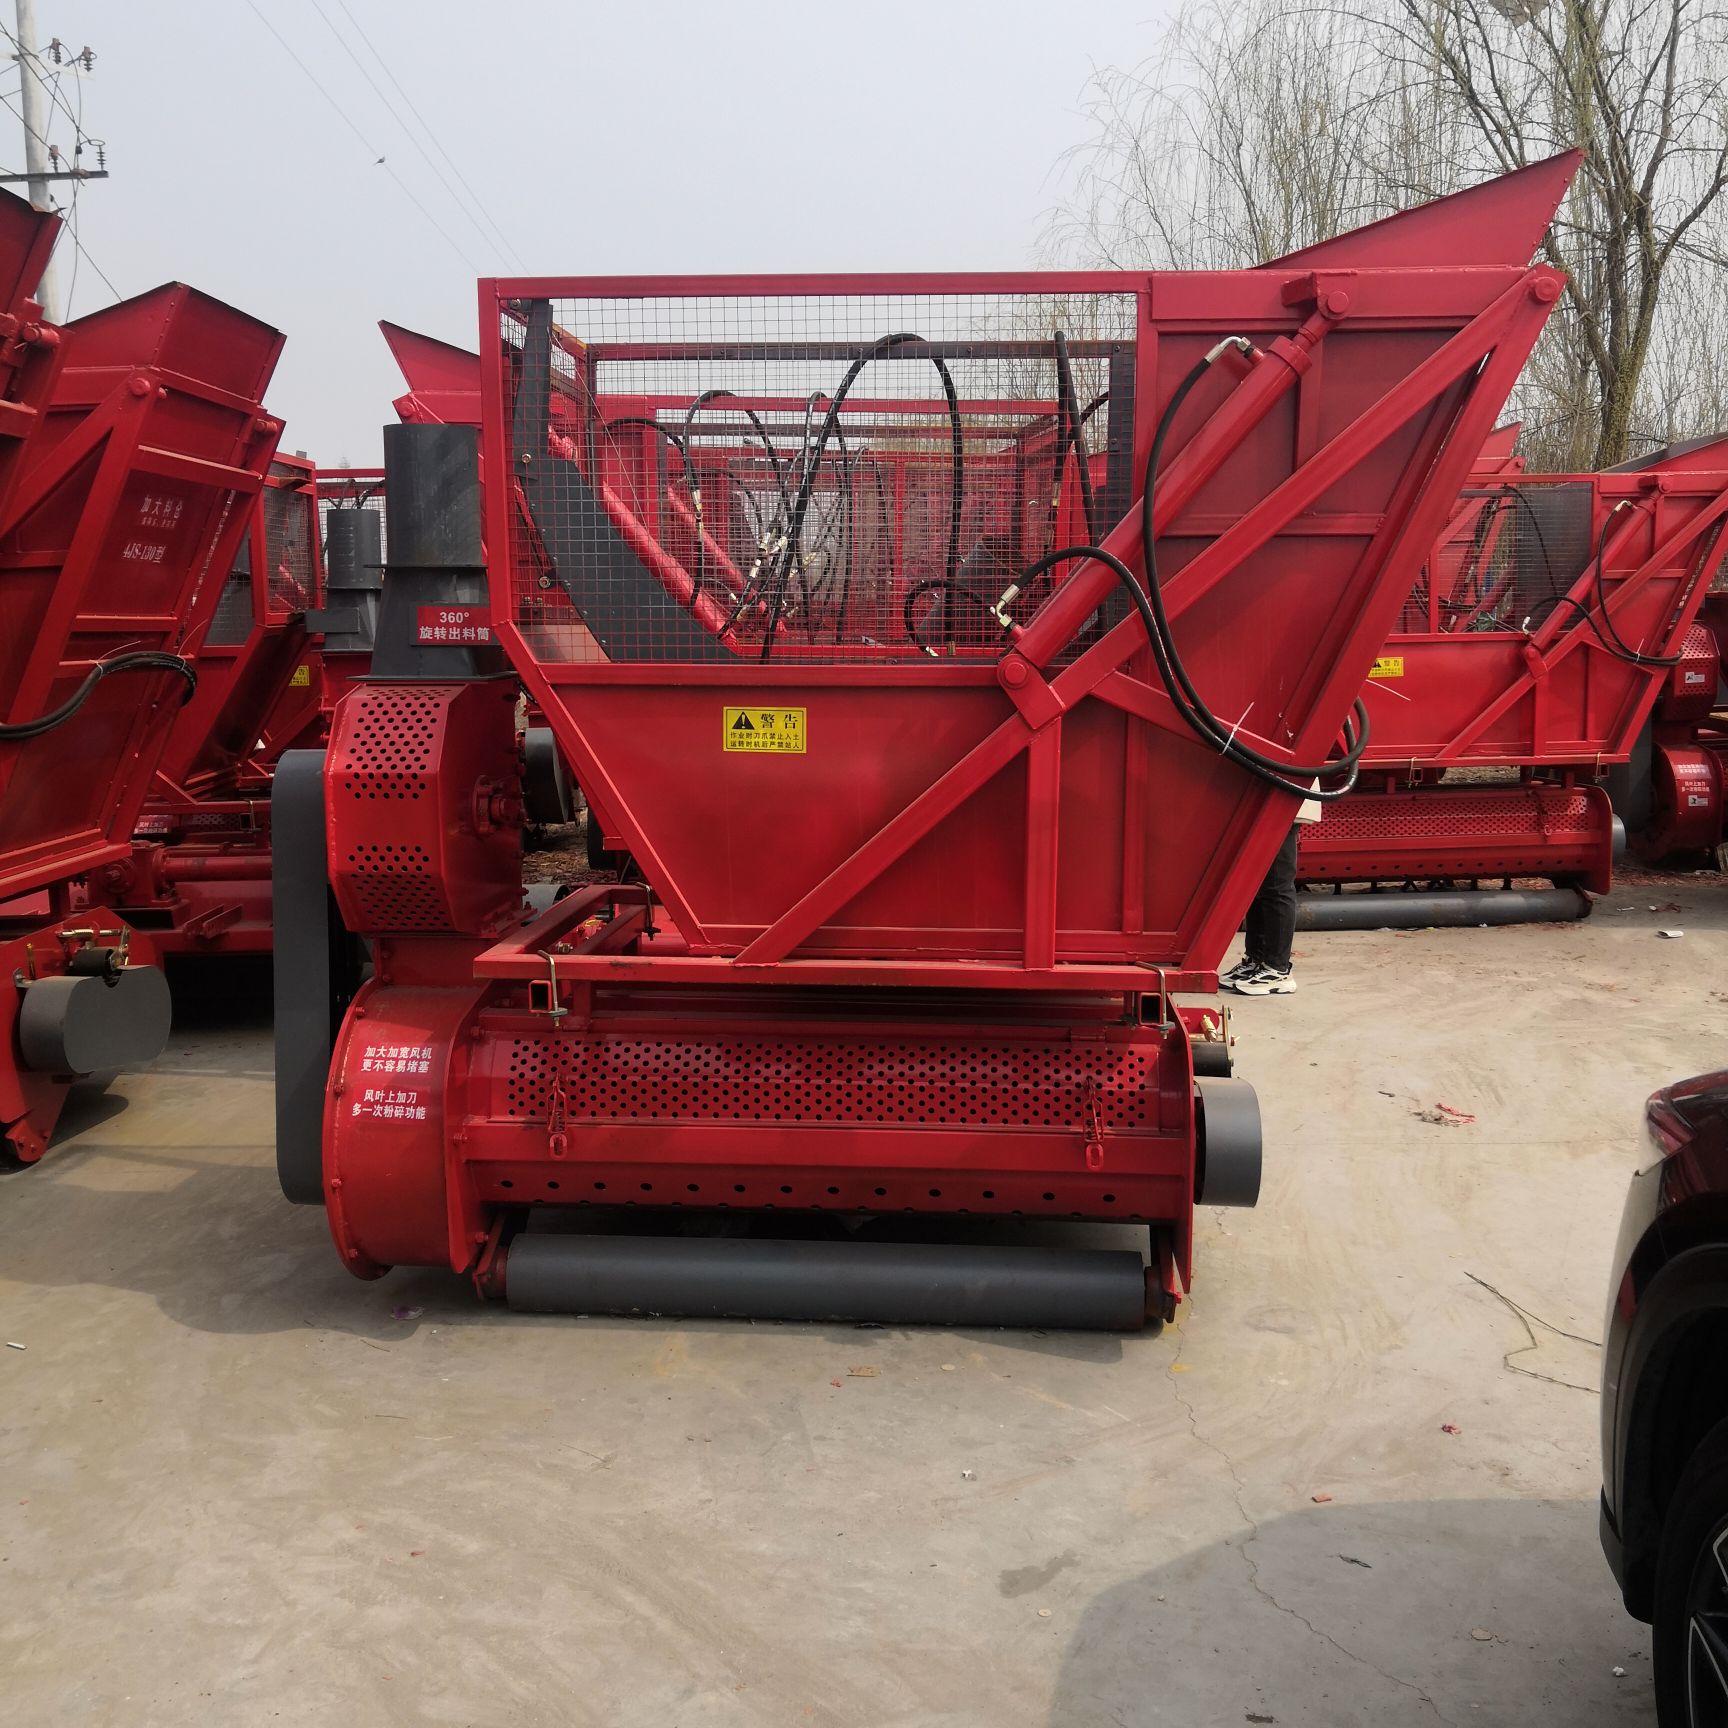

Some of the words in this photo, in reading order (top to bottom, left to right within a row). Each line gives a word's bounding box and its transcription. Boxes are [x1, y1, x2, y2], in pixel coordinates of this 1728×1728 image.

[439, 611, 470, 623] 360°
[419, 626, 490, 641] 旋转出料筒
[760, 713, 798, 730] 警告
[364, 1045, 432, 1060] 加大加宽风机
[361, 1058, 430, 1073] 更不容易堵塞
[363, 1089, 417, 1104] 风叶上加刀
[352, 1102, 426, 1120] 多一次粉碎功能
